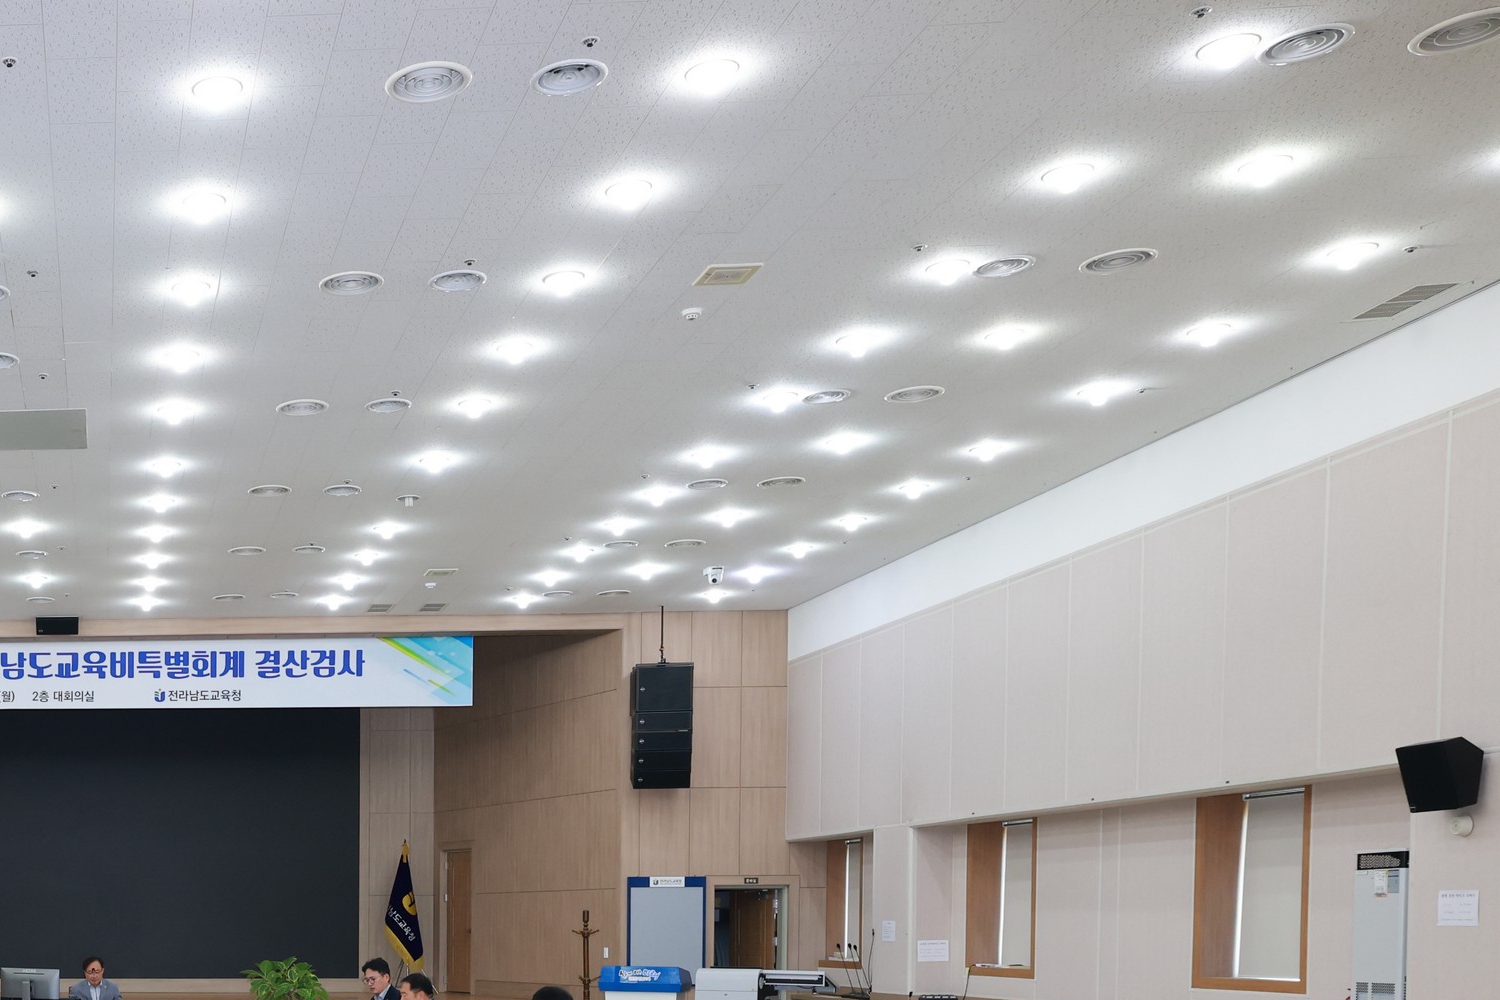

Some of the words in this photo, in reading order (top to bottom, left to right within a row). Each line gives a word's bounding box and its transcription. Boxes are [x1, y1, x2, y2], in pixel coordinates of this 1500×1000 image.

[255, 649, 366, 679] 결산검사
[32, 690, 50, 703] 2층
[53, 690, 95, 703] 대회의실
[168, 689, 242, 702] 전라남도교육청
[388, 906, 415, 941] 남도교육청
